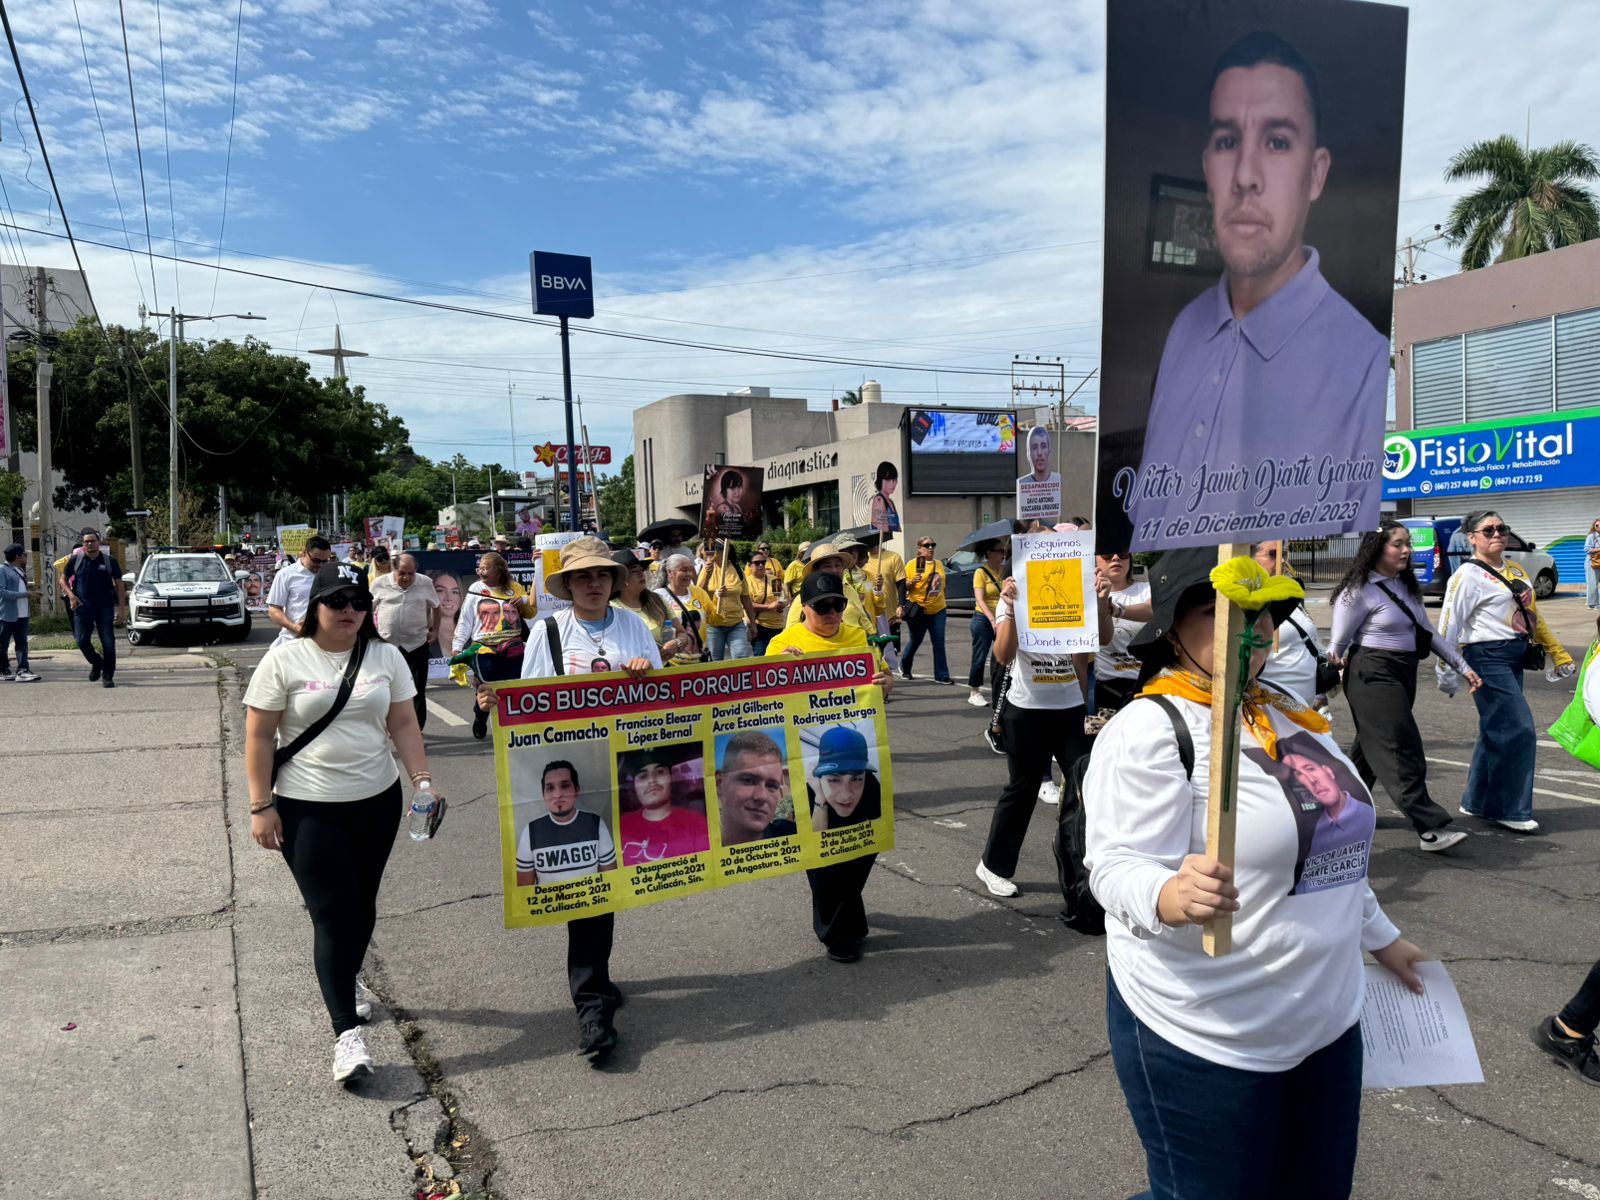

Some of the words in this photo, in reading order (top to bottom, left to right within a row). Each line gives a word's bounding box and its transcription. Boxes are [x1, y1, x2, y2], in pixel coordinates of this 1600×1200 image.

[541, 274, 587, 291] BBVA
[1420, 422, 1573, 468] FisioVital
[1452, 466, 1460, 474] de
[1462, 465, 1485, 473] Terapia
[1512, 458, 1560, 469] Rehabilitación
[1021, 482, 1059, 490] DESAPARECIDO
[1113, 461, 1185, 512] Victor
[1187, 460, 1250, 512] Javier
[1254, 454, 1313, 507] Diarte
[1316, 452, 1376, 502] Garcia
[1434, 482, 1450, 491] (667)
[1450, 481, 1460, 489] 257
[1495, 476, 1511, 486] (667)
[1511, 475, 1524, 484] 472
[1525, 474, 1533, 483] 72
[1535, 473, 1542, 482] 93
[1139, 519, 1161, 541] 11
[1165, 517, 1189, 538] de
[1193, 508, 1283, 535] Diciembre
[1288, 504, 1317, 525] del
[1318, 500, 1359, 522] 2023
[1019, 539, 1030, 550] Te
[1034, 538, 1081, 552] seguimos
[337, 565, 358, 584] NY
[506, 691, 551, 716] LOS
[556, 680, 676, 711] BUSCAMOS,
[680, 671, 752, 698] PORQUE
[755, 667, 788, 689] LOS
[792, 659, 867, 685] AMAMOS
[809, 689, 856, 709] Rafael
[712, 704, 740, 719] David
[742, 700, 784, 714] Gilberto
[793, 711, 842, 726] Rodriguez
[844, 706, 877, 719] Burgos
[616, 716, 664, 731] Francisco
[665, 711, 702, 725] Eleazar
[712, 719, 735, 732] Arce
[737, 714, 785, 728] Escalante
[508, 731, 541, 748] Juan
[543, 722, 609, 744] Camacho
[628, 731, 658, 746] López
[660, 724, 692, 740] Bernal
[821, 824, 865, 839] Desapareció
[866, 821, 872, 829] el
[829, 838, 839, 846] de
[840, 834, 857, 845] Julio
[858, 829, 874, 840] 2021
[536, 844, 598, 868] SWAGGY
[720, 858, 732, 867] 20
[733, 855, 744, 864] de
[747, 850, 778, 862] Octubre
[779, 845, 801, 855] 2021
[729, 841, 780, 856] Desapareció
[781, 838, 789, 847] el
[830, 843, 863, 855] Culiacán,
[863, 837, 876, 847] Sin.
[1305, 851, 1336, 868] VICTOR
[1337, 841, 1366, 857] JAVIER
[631, 877, 640, 886] 13
[642, 874, 653, 884] de
[654, 867, 684, 883] Agosto
[684, 863, 706, 874] 2021
[636, 857, 688, 875] Desapareció
[689, 854, 698, 864] el
[724, 868, 735, 876] en
[736, 860, 782, 874] Angostura,
[783, 856, 799, 865] Sin.
[1302, 864, 1329, 879] DIARTE
[527, 896, 539, 905] 12
[541, 894, 553, 904] de
[555, 890, 587, 902] Marzo
[588, 883, 611, 895] 2021
[534, 876, 594, 895] Desapareció
[595, 873, 603, 883] el
[635, 888, 646, 896] en
[646, 880, 687, 893] Culiacán,
[688, 875, 704, 885] Sin.
[530, 907, 543, 916] en
[545, 900, 590, 913] Culiacán,
[592, 895, 609, 905] Sin.
